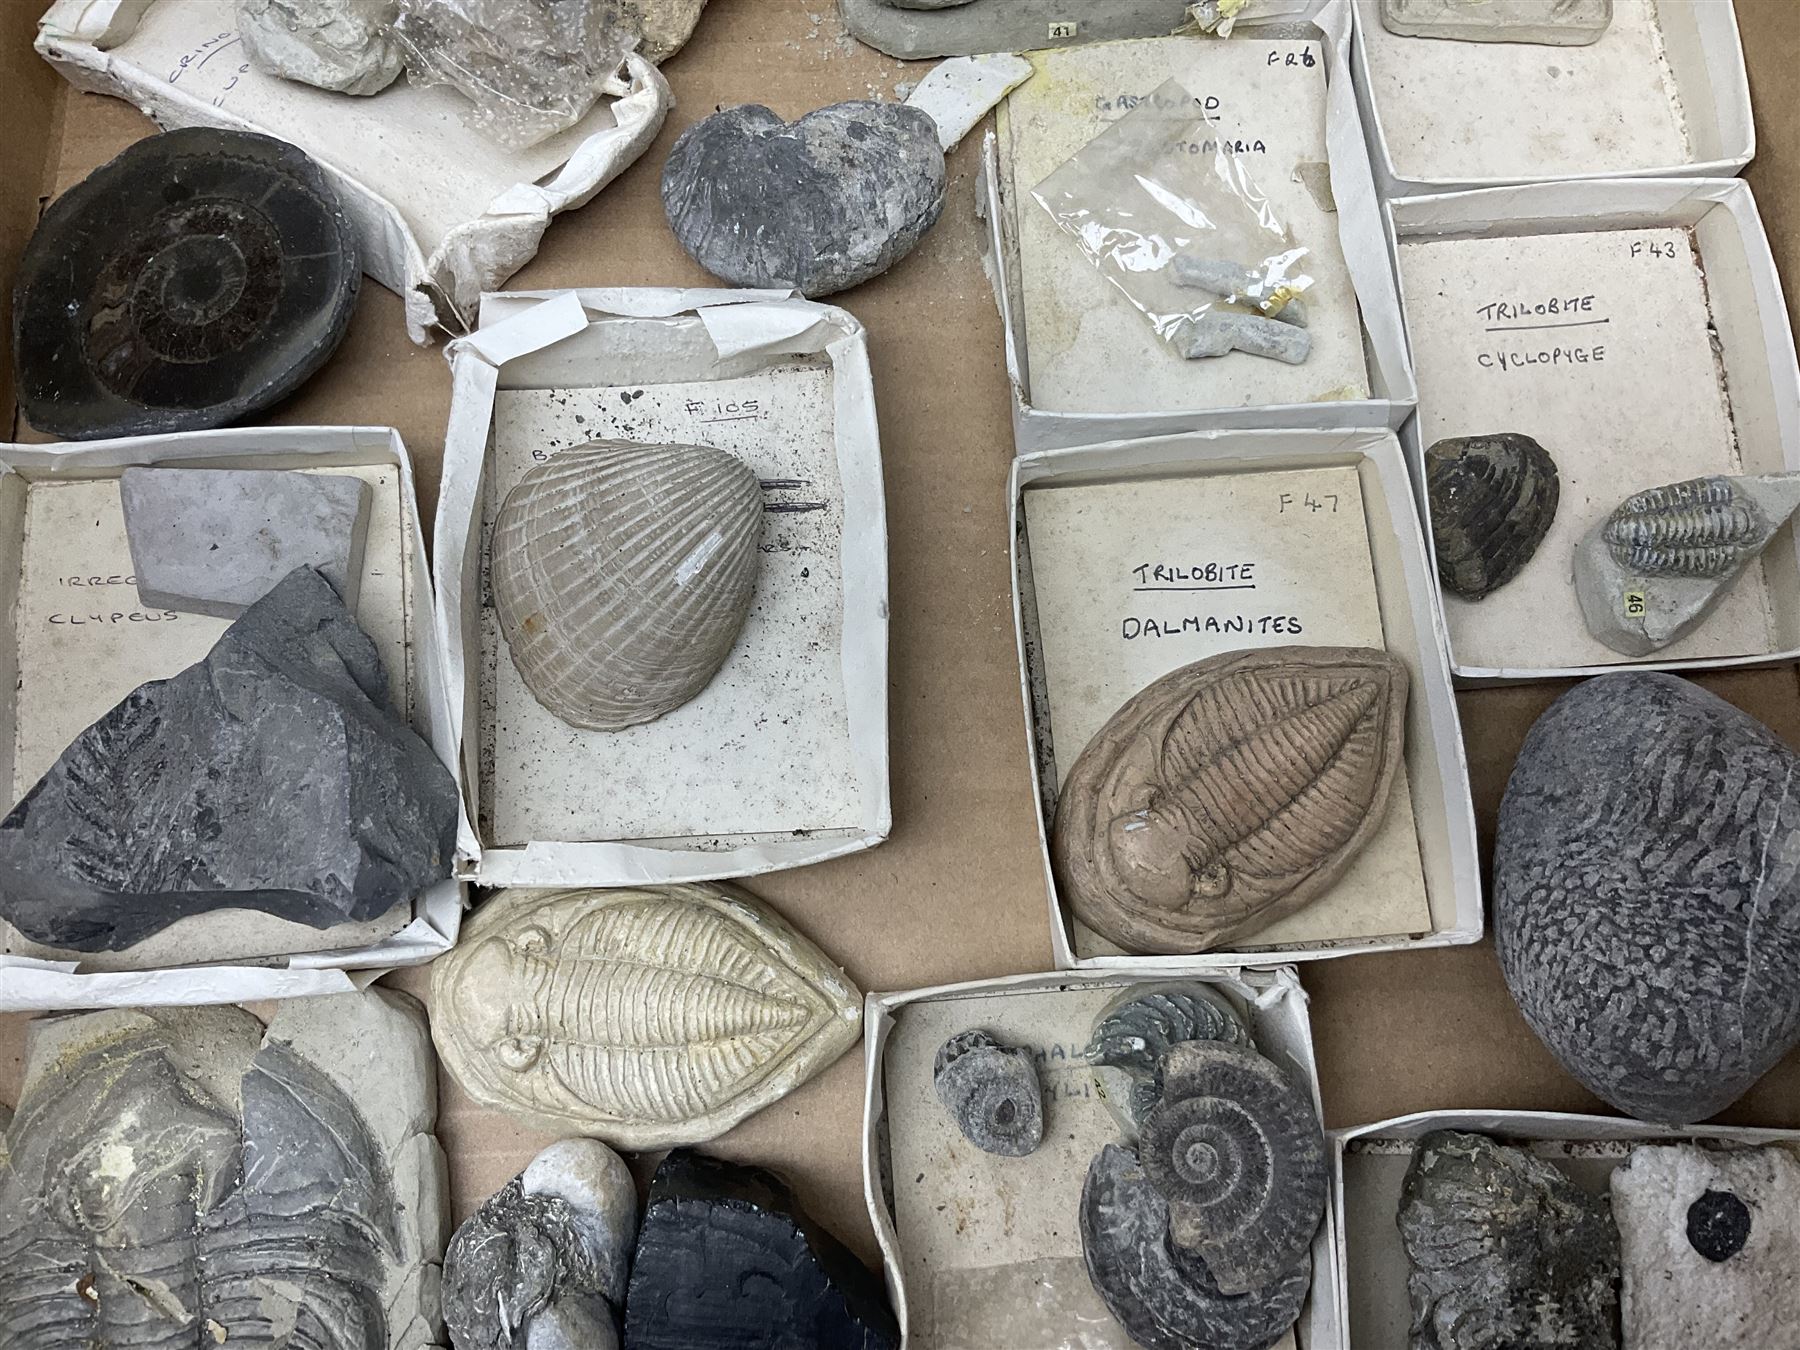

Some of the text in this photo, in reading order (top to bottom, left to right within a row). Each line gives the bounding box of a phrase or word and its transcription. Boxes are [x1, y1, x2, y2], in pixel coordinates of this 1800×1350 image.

[169, 32, 232, 83] CRINO
[1631, 241, 1676, 259] F 43
[1476, 295, 1596, 322] TRILOBITE
[1478, 345, 1605, 371] CYCLOPYGE
[1280, 492, 1339, 513] F 47
[1132, 562, 1256, 584] TRILOBITE
[1628, 595, 1643, 613] 46
[48, 609, 178, 625] CLYPEUS
[1122, 615, 1303, 640] DALMANITES
